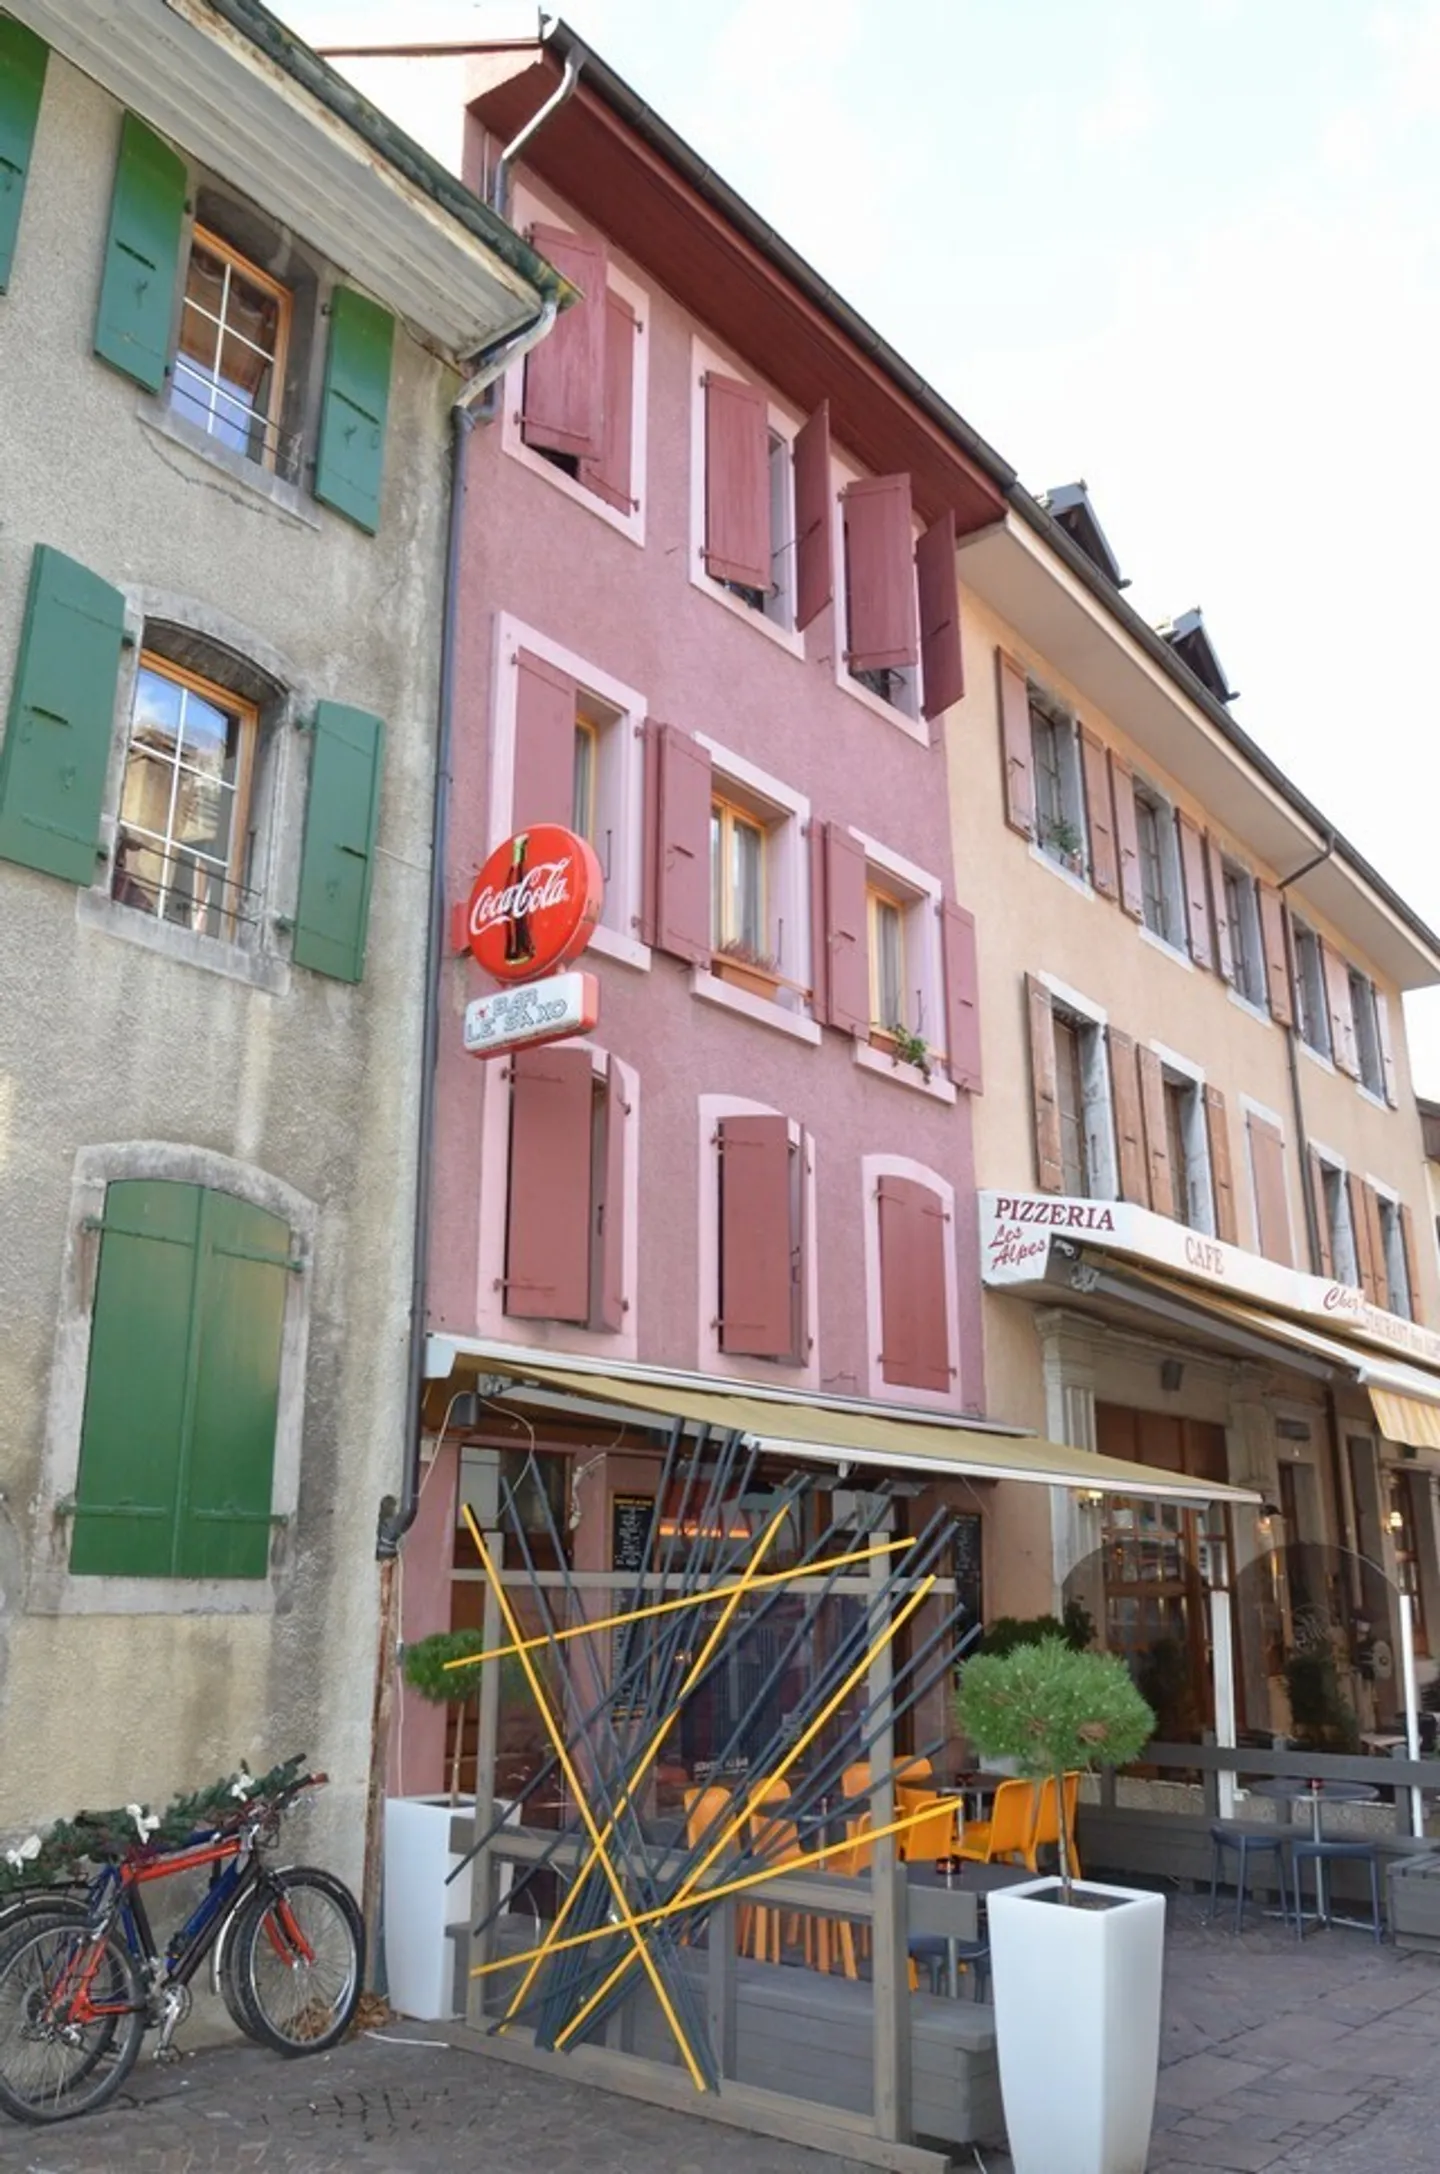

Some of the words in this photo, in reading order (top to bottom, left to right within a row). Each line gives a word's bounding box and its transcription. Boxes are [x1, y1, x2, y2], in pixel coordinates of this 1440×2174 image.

[994, 1197, 1116, 1231] PIZZERIA
[987, 1224, 1023, 1249] Les
[991, 1239, 1046, 1270] Alpes
[1185, 1236, 1225, 1275] CAFE
